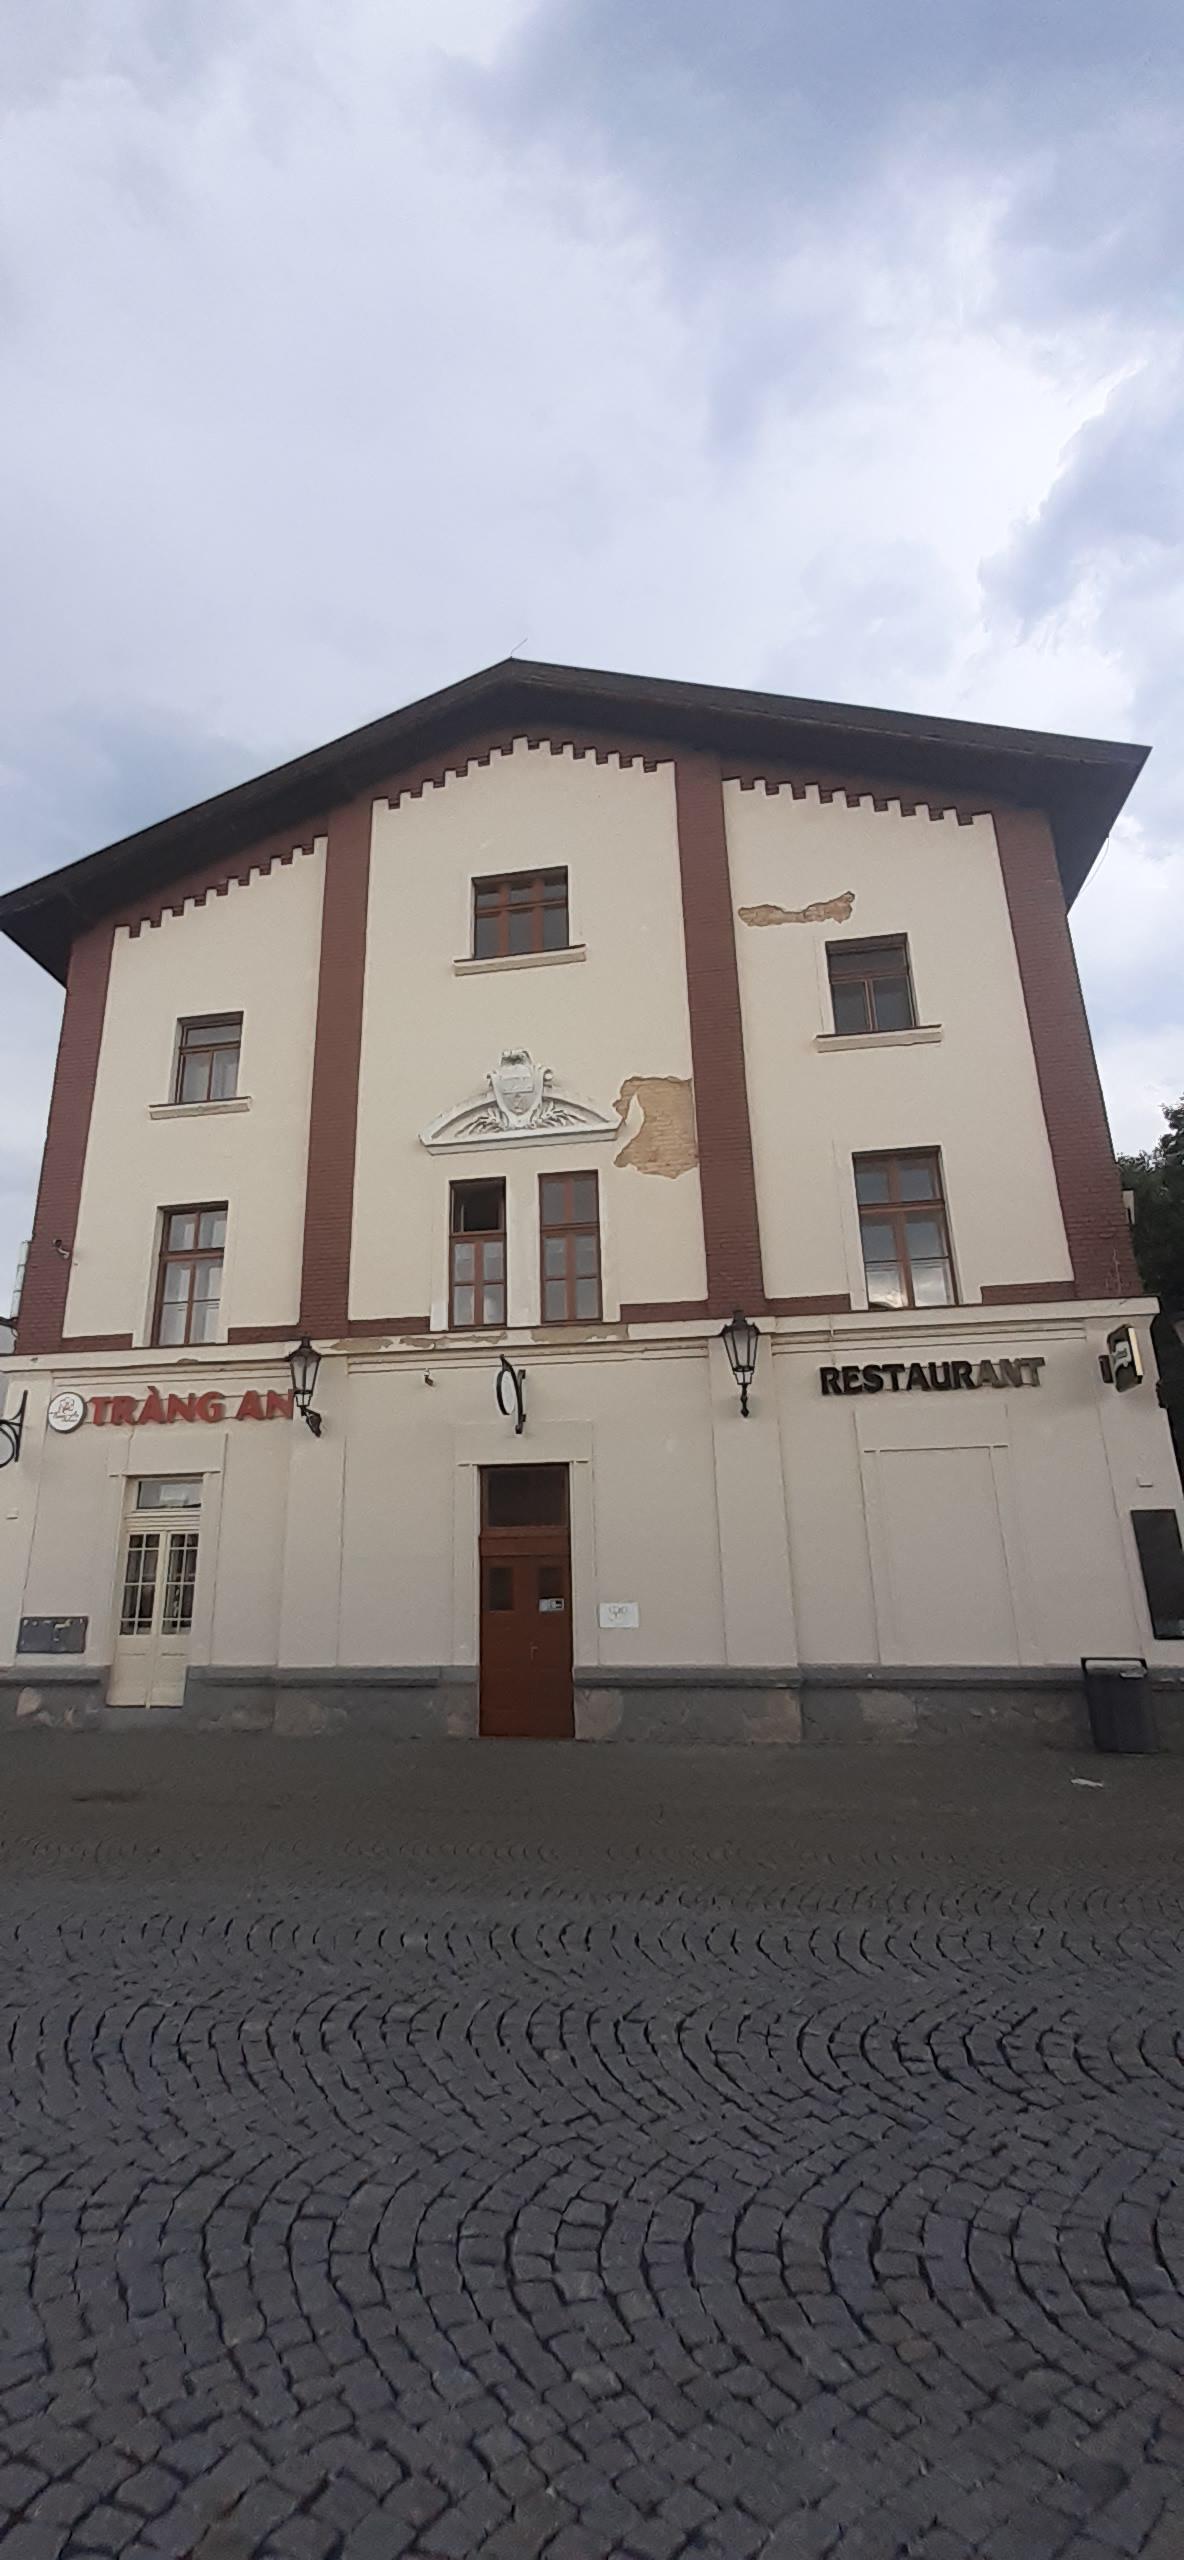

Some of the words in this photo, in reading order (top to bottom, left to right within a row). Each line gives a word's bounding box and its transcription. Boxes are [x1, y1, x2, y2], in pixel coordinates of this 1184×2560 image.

[819, 1357, 1046, 1395] RESTAURANT
[90, 1385, 226, 1426] TRÀNG
[235, 1388, 295, 1421] AN
